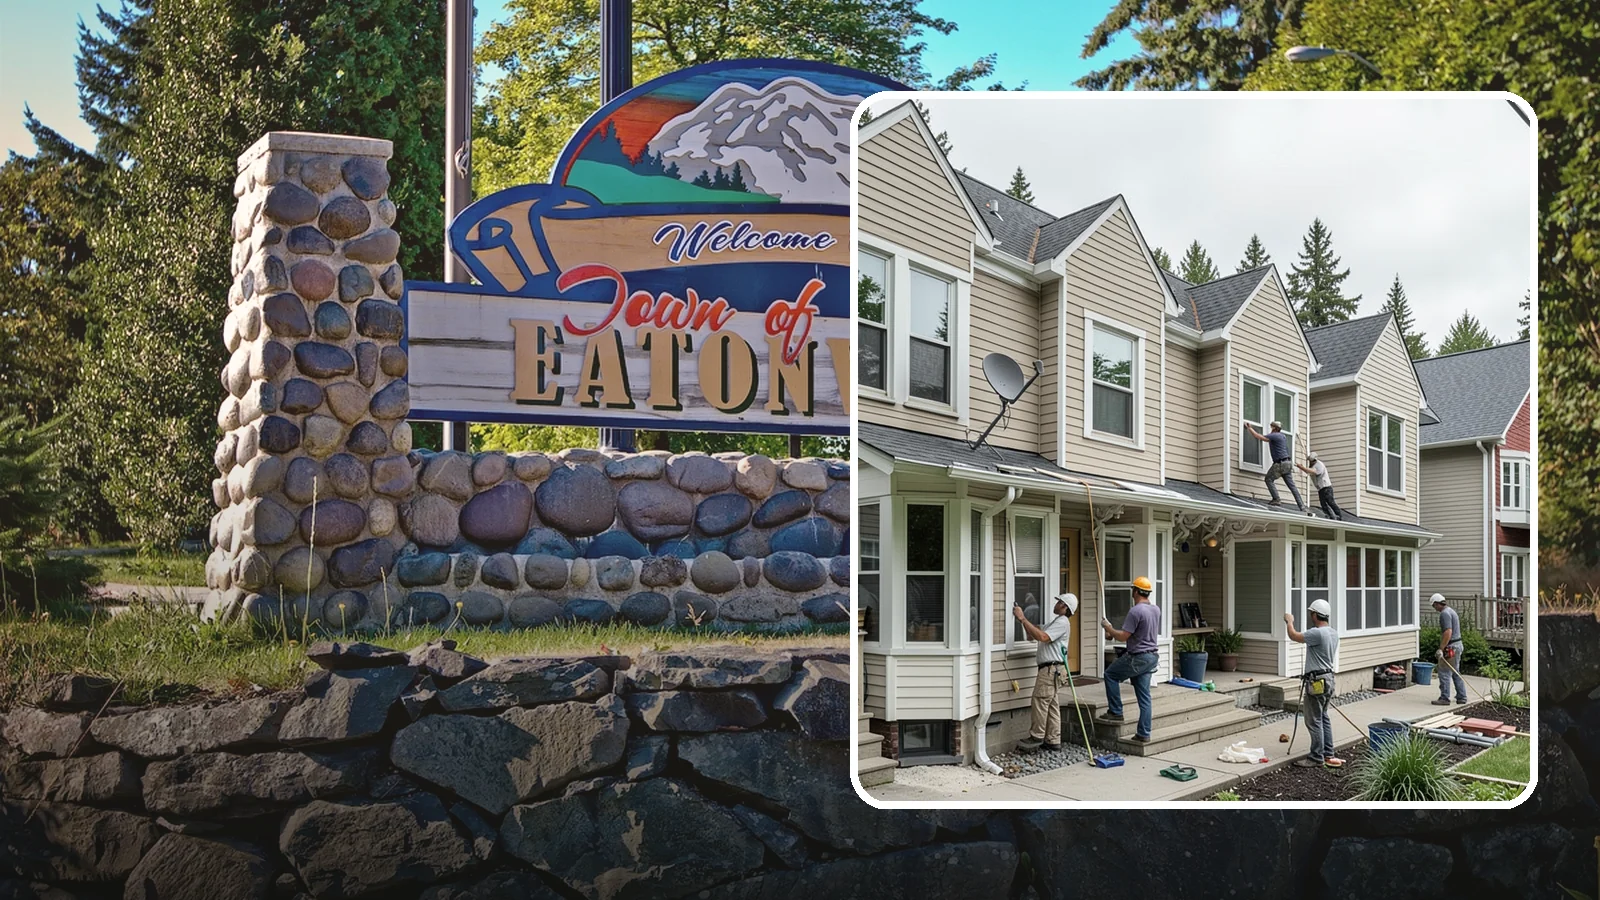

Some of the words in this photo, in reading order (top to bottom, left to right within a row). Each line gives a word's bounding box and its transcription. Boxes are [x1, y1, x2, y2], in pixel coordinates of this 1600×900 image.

[653, 220, 837, 263] Welcome
[556, 263, 737, 336] Town
[765, 278, 826, 365] of
